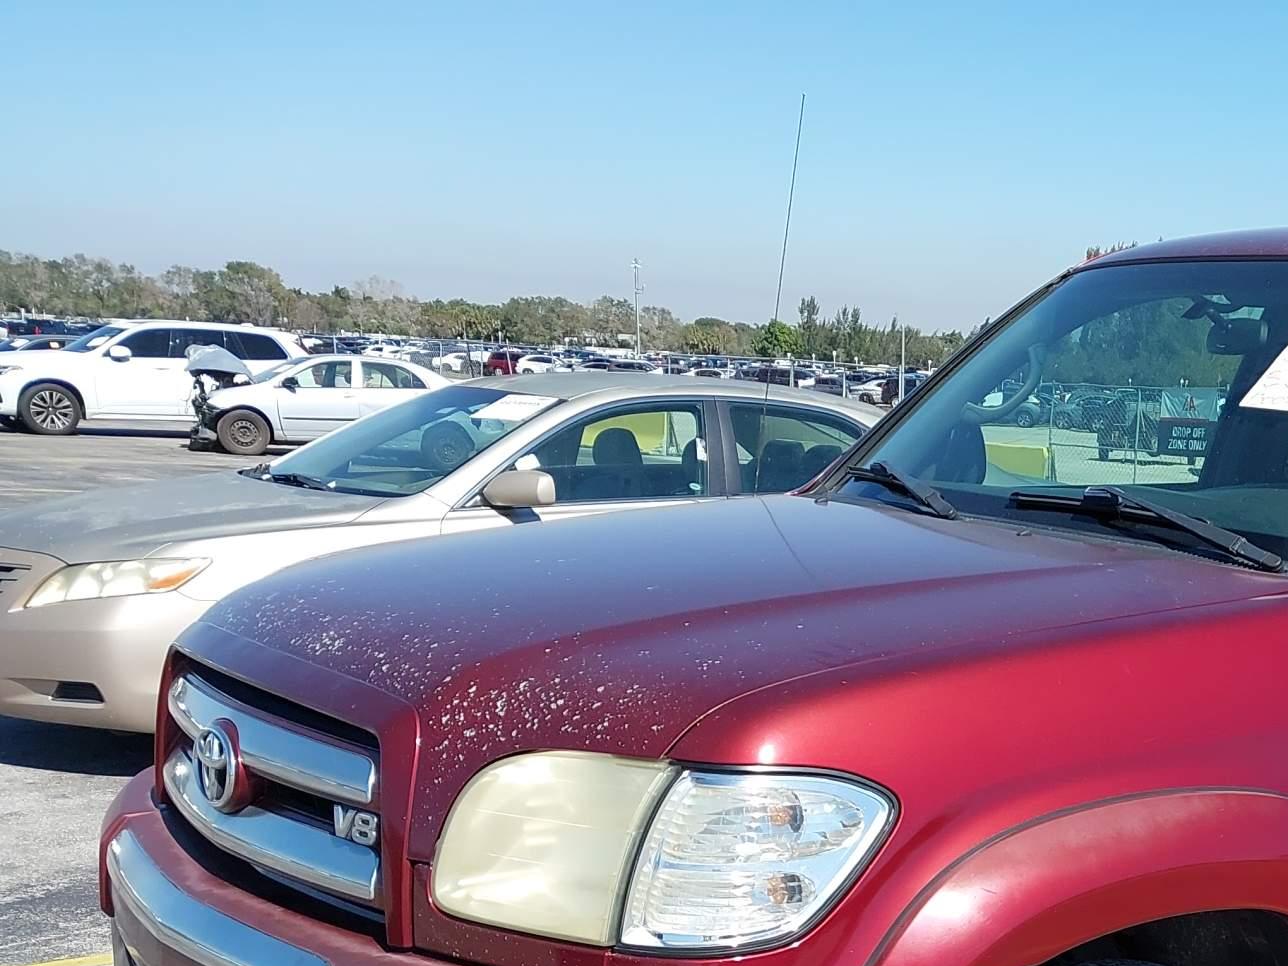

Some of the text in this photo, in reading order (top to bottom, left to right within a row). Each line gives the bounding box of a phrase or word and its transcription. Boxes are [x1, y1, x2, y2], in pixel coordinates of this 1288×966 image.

[1172, 426, 1206, 438] DROP OFF
[1168, 439, 1207, 451] ZONE ONLY
[333, 804, 378, 846] V8
